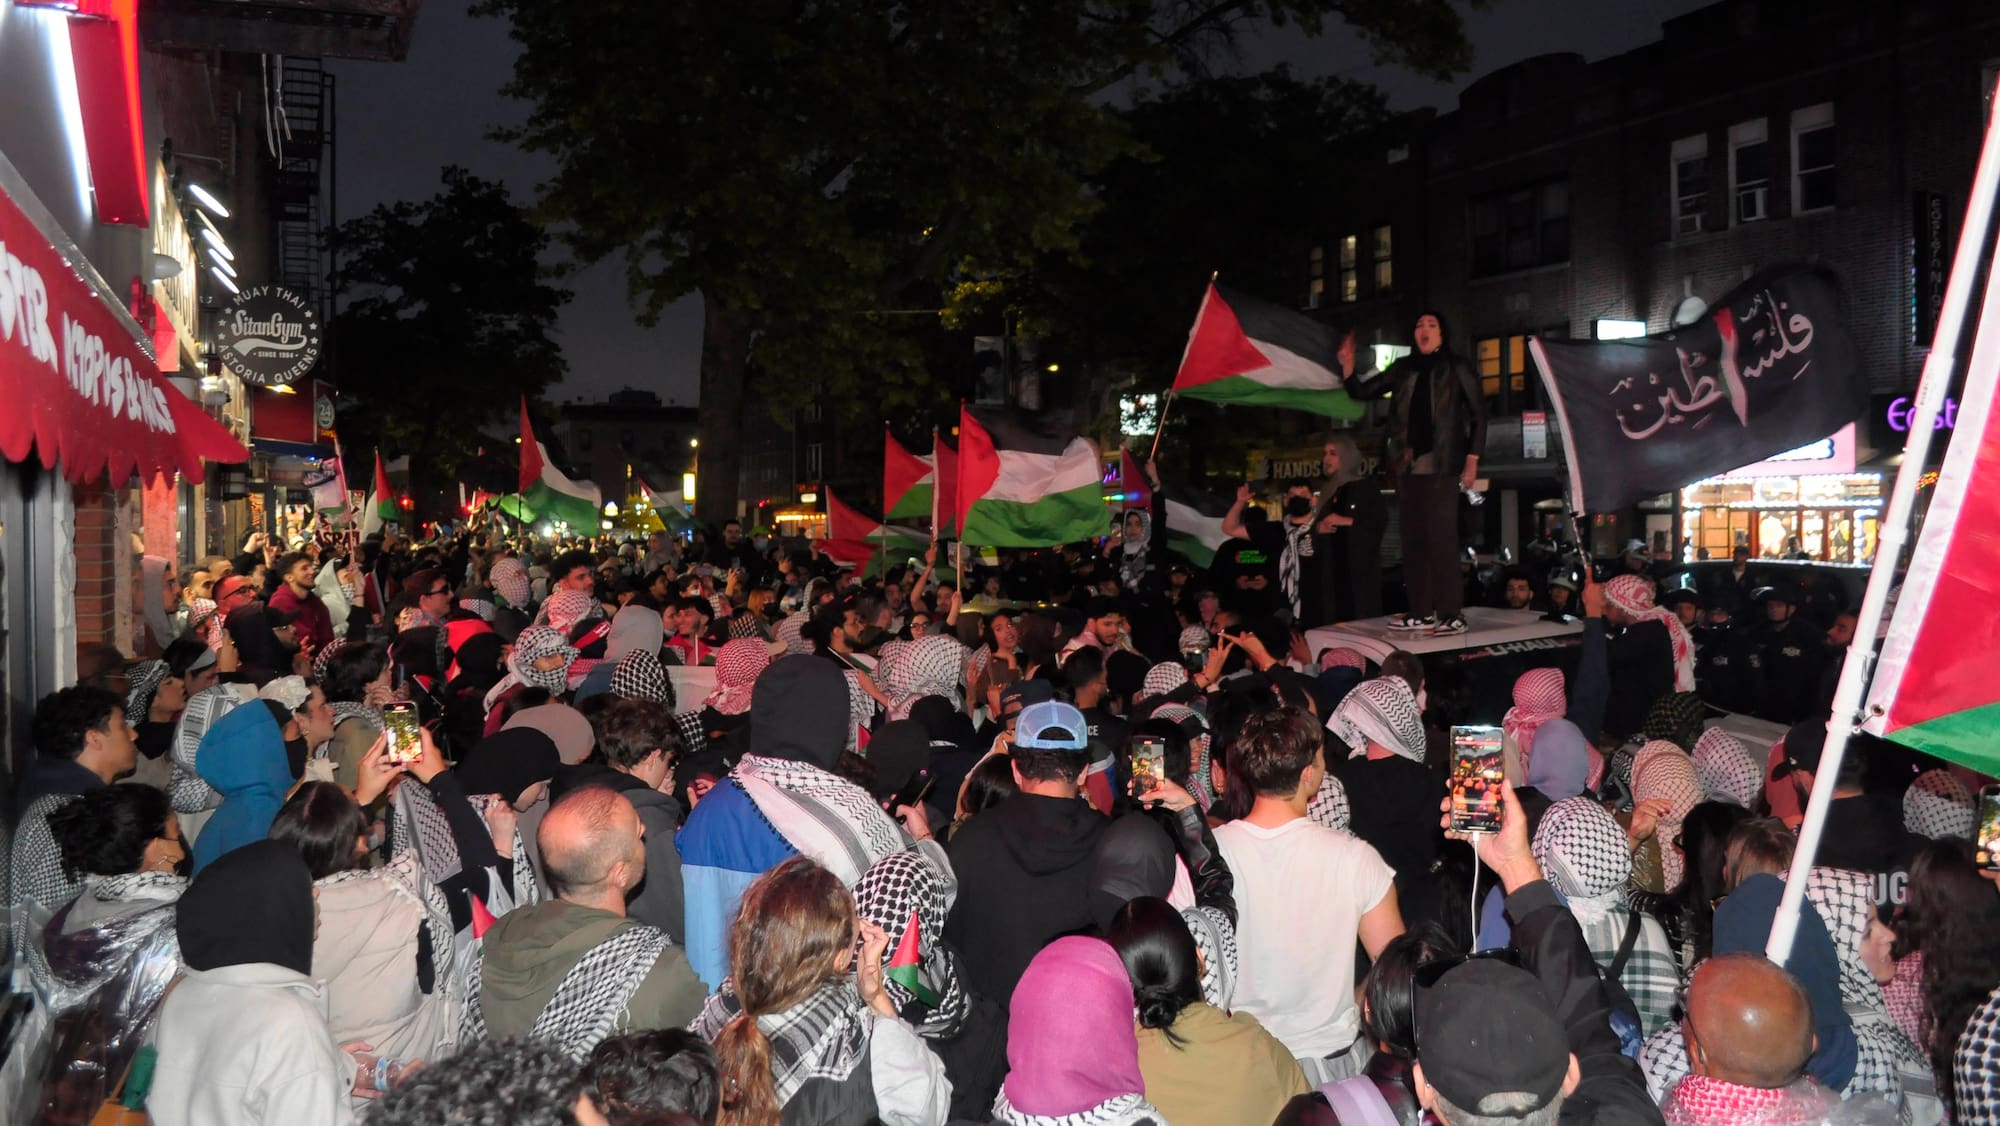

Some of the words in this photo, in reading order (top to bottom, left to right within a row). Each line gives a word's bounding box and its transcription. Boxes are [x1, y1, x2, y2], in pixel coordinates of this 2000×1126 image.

[233, 286, 269, 306] MUAY
[275, 287, 306, 310] THAI
[231, 309, 304, 344] SitanGym
[219, 344, 266, 384] ASTORIA
[273, 346, 317, 384] QUEENS
[1273, 461, 1321, 479] HANDS
[1485, 638, 1568, 657] U-HAUL
